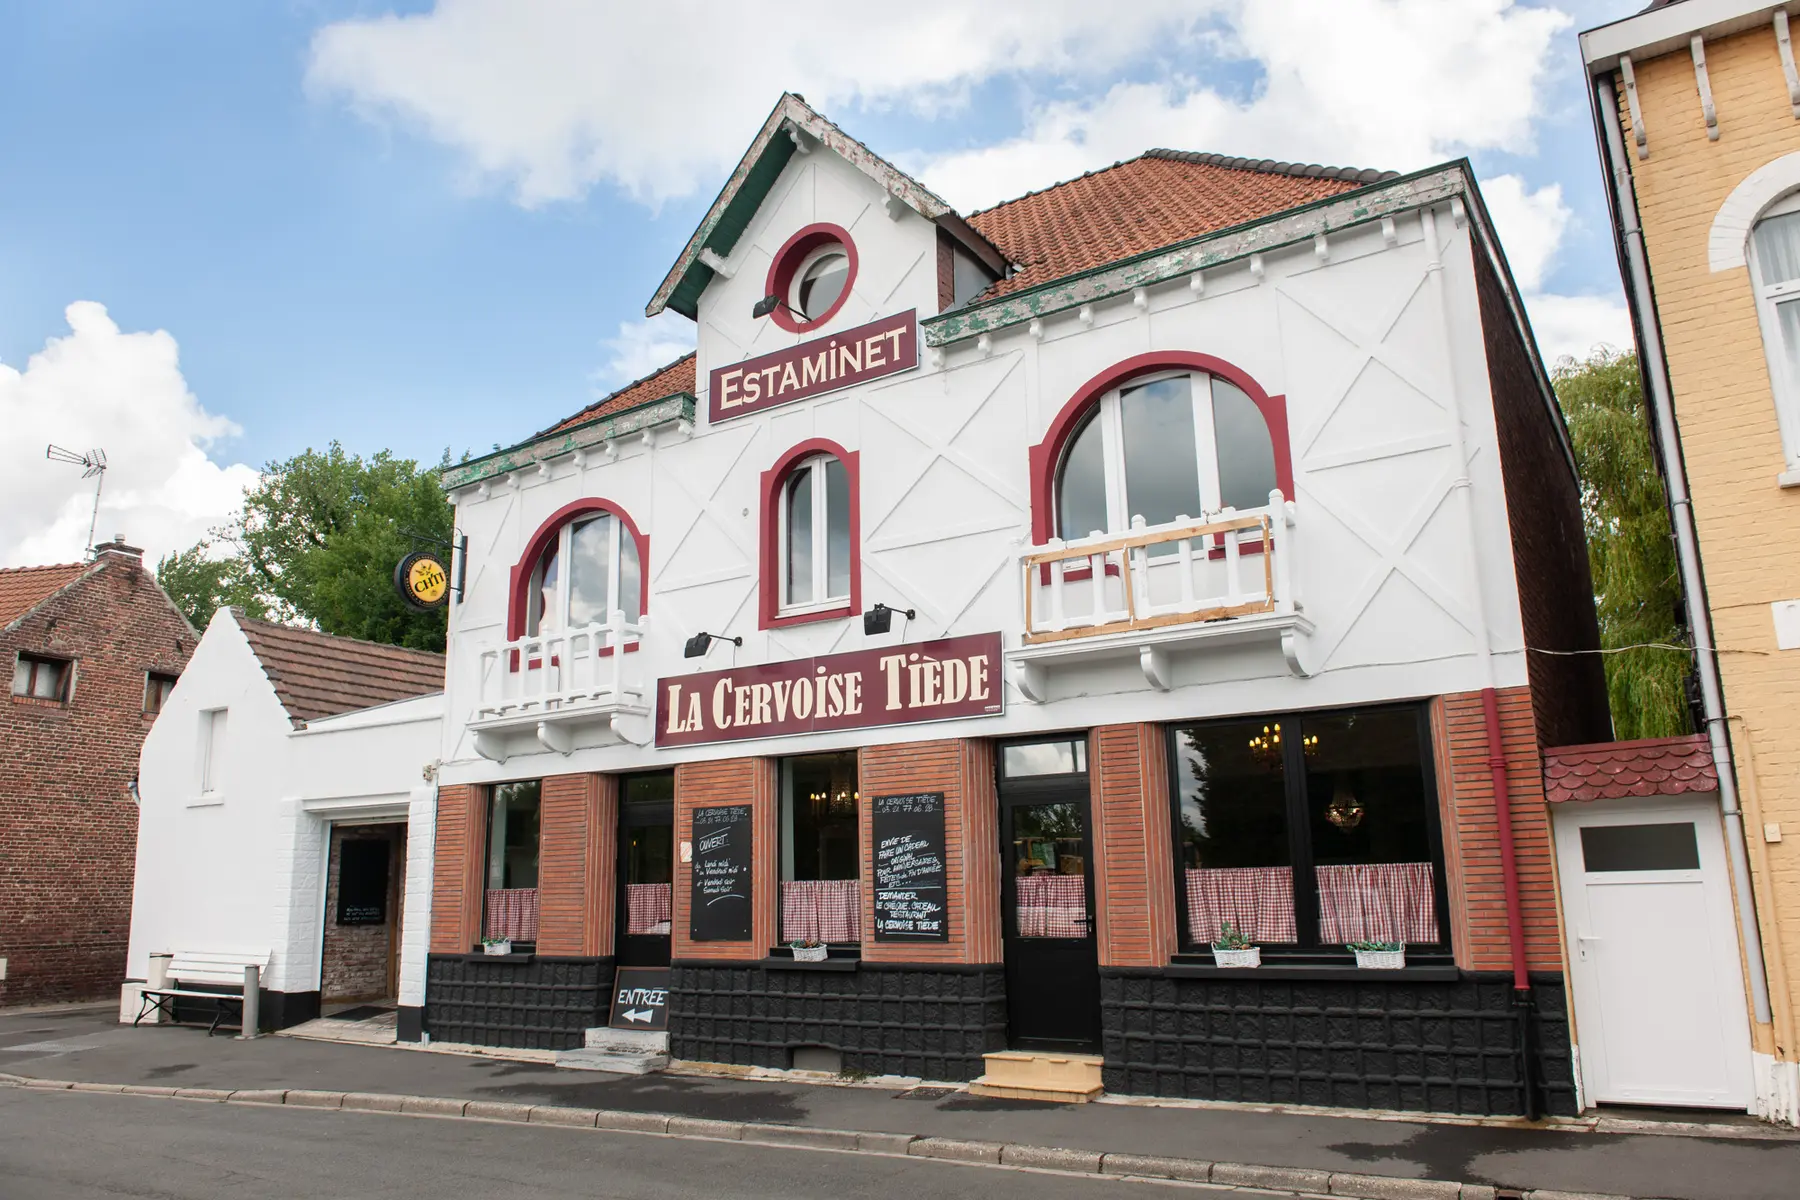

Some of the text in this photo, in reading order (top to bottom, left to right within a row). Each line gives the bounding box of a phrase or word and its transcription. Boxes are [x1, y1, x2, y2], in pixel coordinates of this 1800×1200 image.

[720, 325, 907, 410] ESTAMINET
[414, 572, 445, 593] CH'TI
[666, 652, 989, 734] LA CERVOISE TIÈDE
[900, 834, 912, 844] DE
[879, 891, 918, 900] DEMANDER
